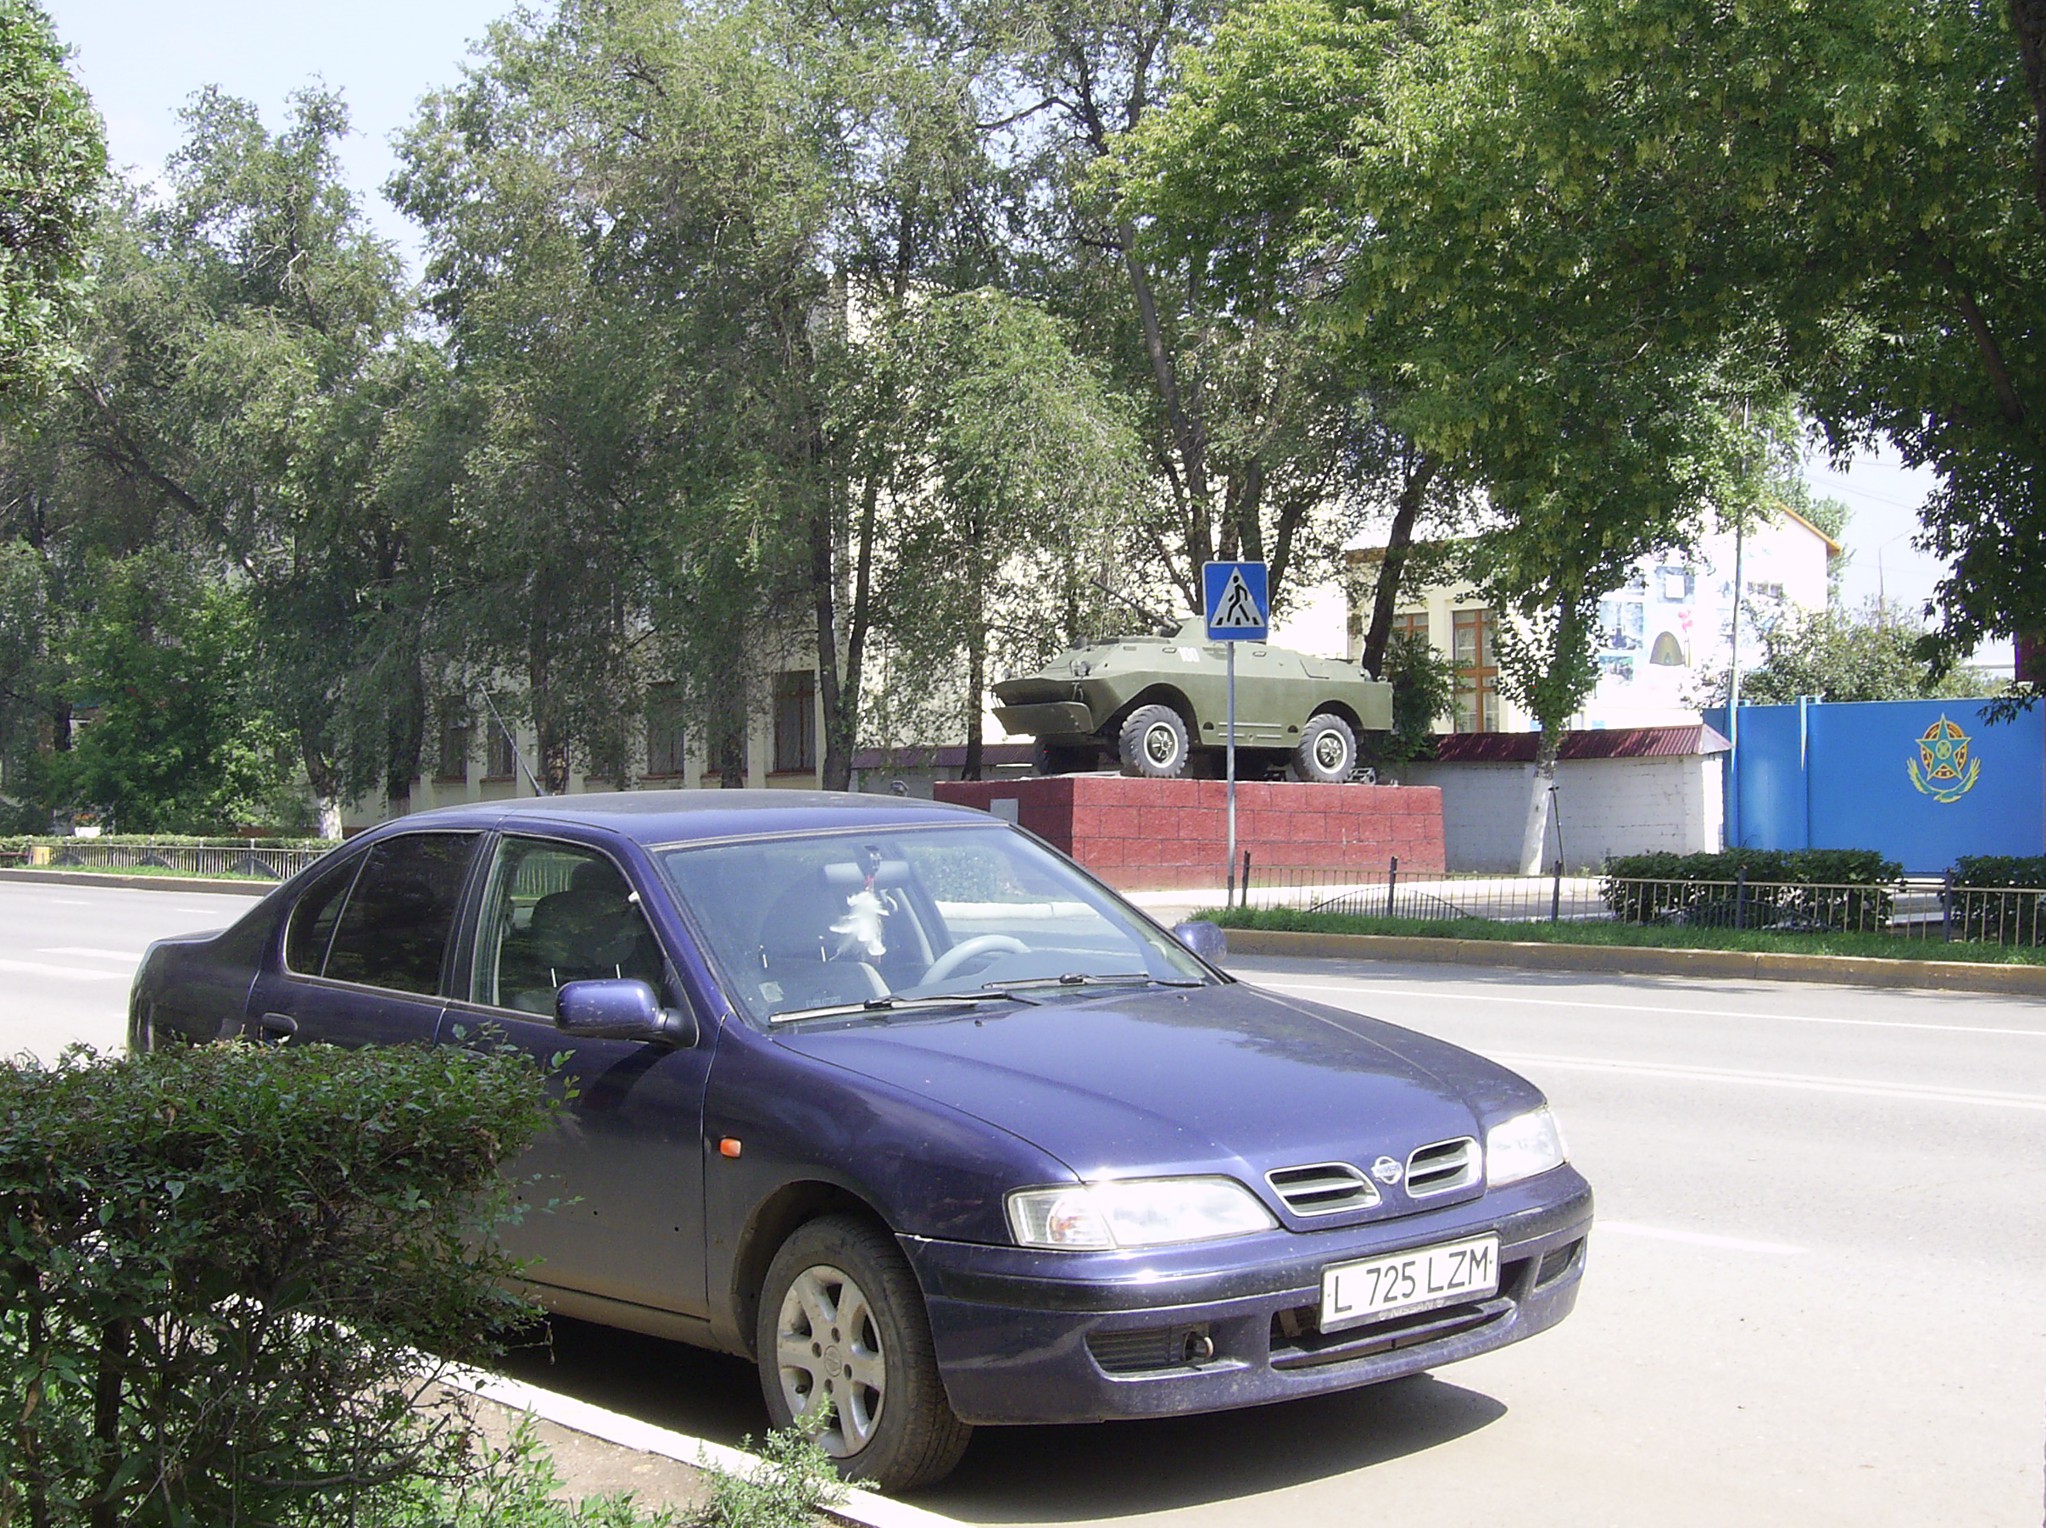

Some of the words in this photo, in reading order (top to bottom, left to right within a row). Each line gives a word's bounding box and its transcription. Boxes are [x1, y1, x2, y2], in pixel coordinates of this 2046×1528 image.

[1334, 1275, 1352, 1313] L
[1366, 1260, 1416, 1306] 725
[1427, 1246, 1489, 1293] LZM
[1390, 1301, 1434, 1317] NISSAN
